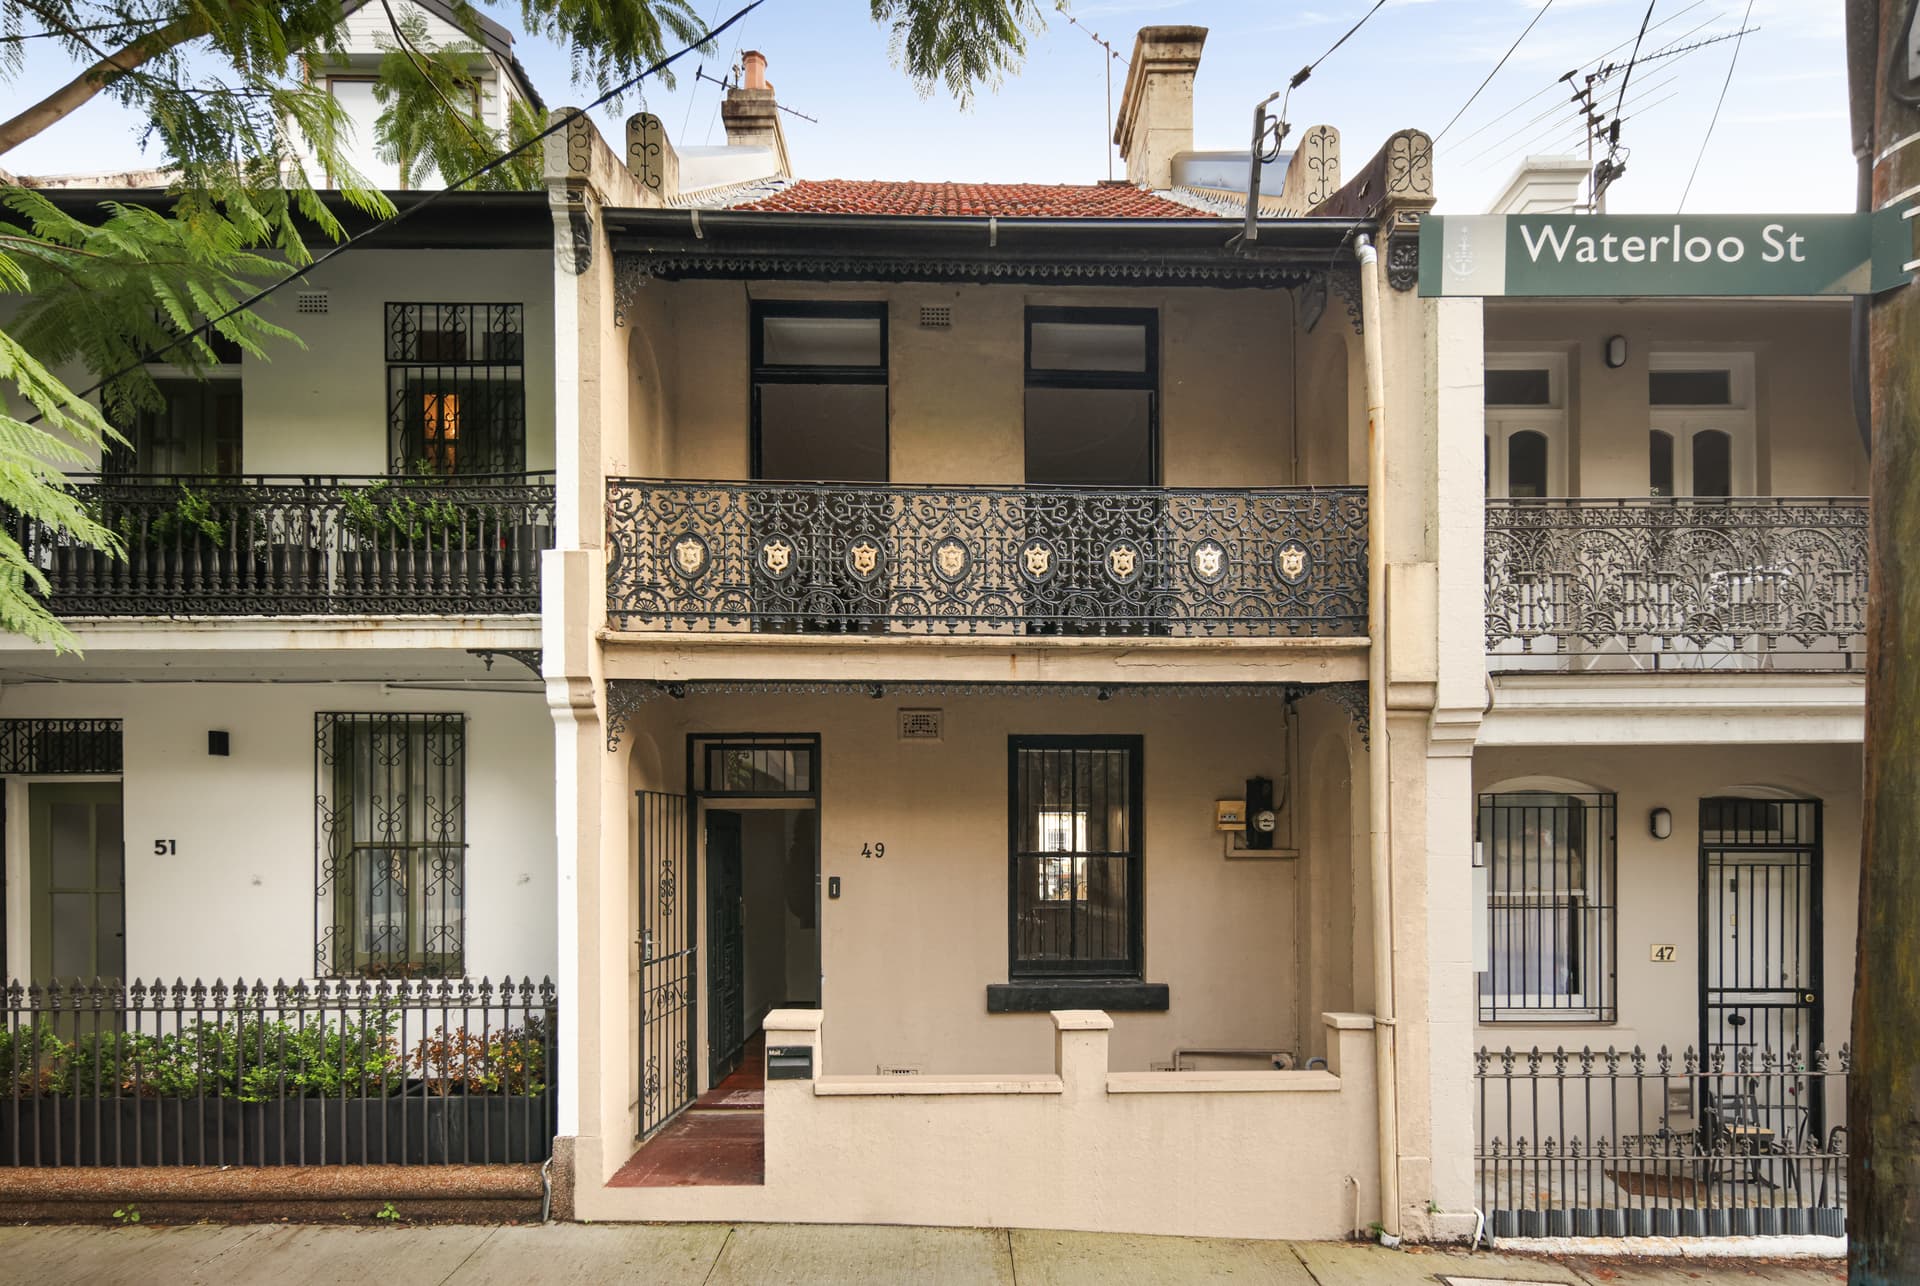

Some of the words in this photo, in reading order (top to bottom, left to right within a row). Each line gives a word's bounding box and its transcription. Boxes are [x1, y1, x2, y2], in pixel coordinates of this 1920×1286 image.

[1520, 224, 1745, 263] Waterloo
[1761, 224, 1806, 263] St
[154, 839, 176, 856] 51
[861, 842, 885, 858] 49
[1655, 946, 1674, 960] 47
